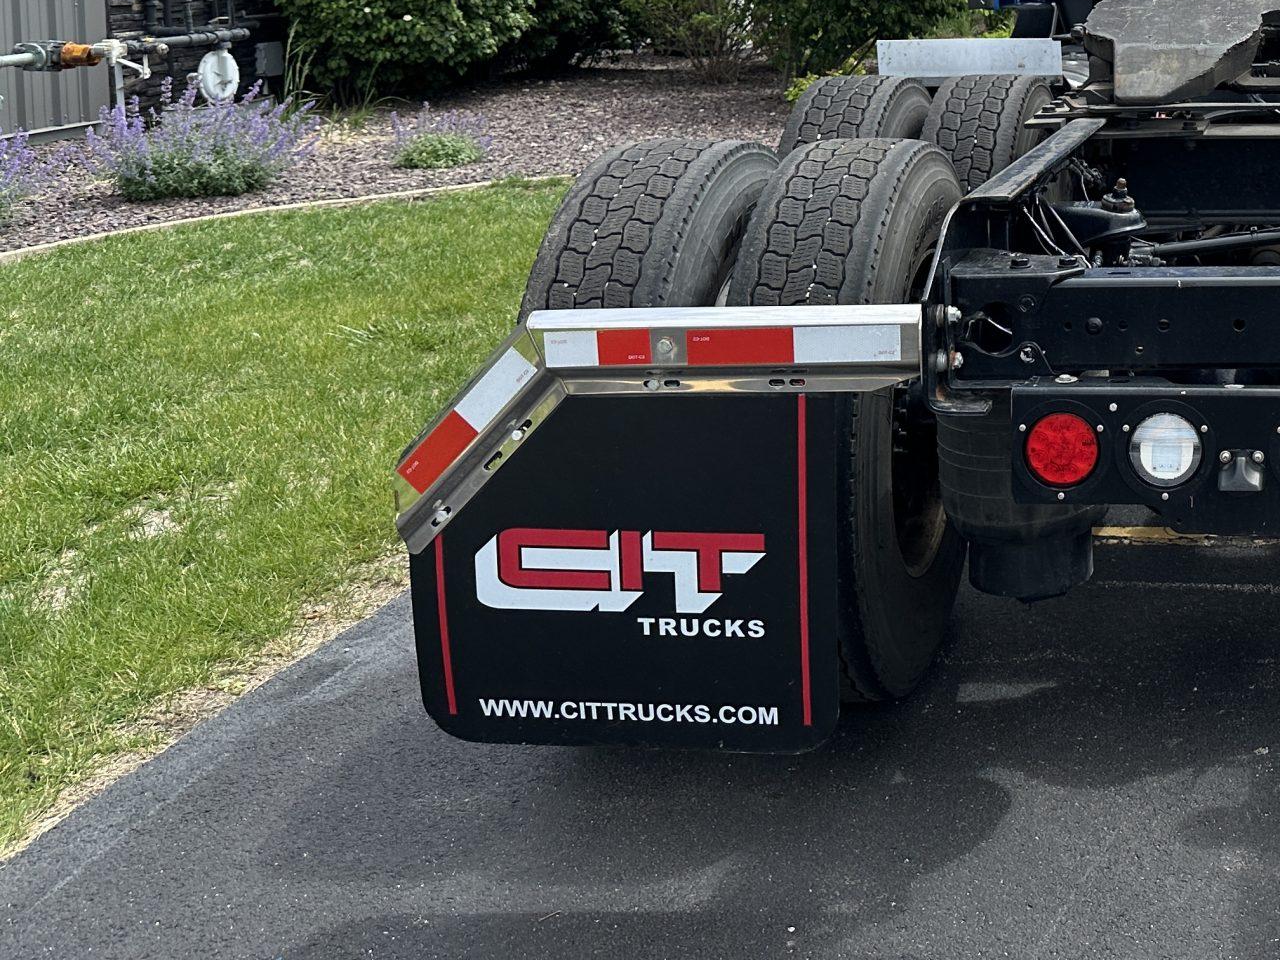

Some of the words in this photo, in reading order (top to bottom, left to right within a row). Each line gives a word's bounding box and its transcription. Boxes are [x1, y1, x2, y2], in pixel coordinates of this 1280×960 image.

[475, 528, 766, 613] CIT
[637, 617, 766, 638] TRUCKS
[479, 698, 779, 725] WWW.CITTRUCKS.COM
